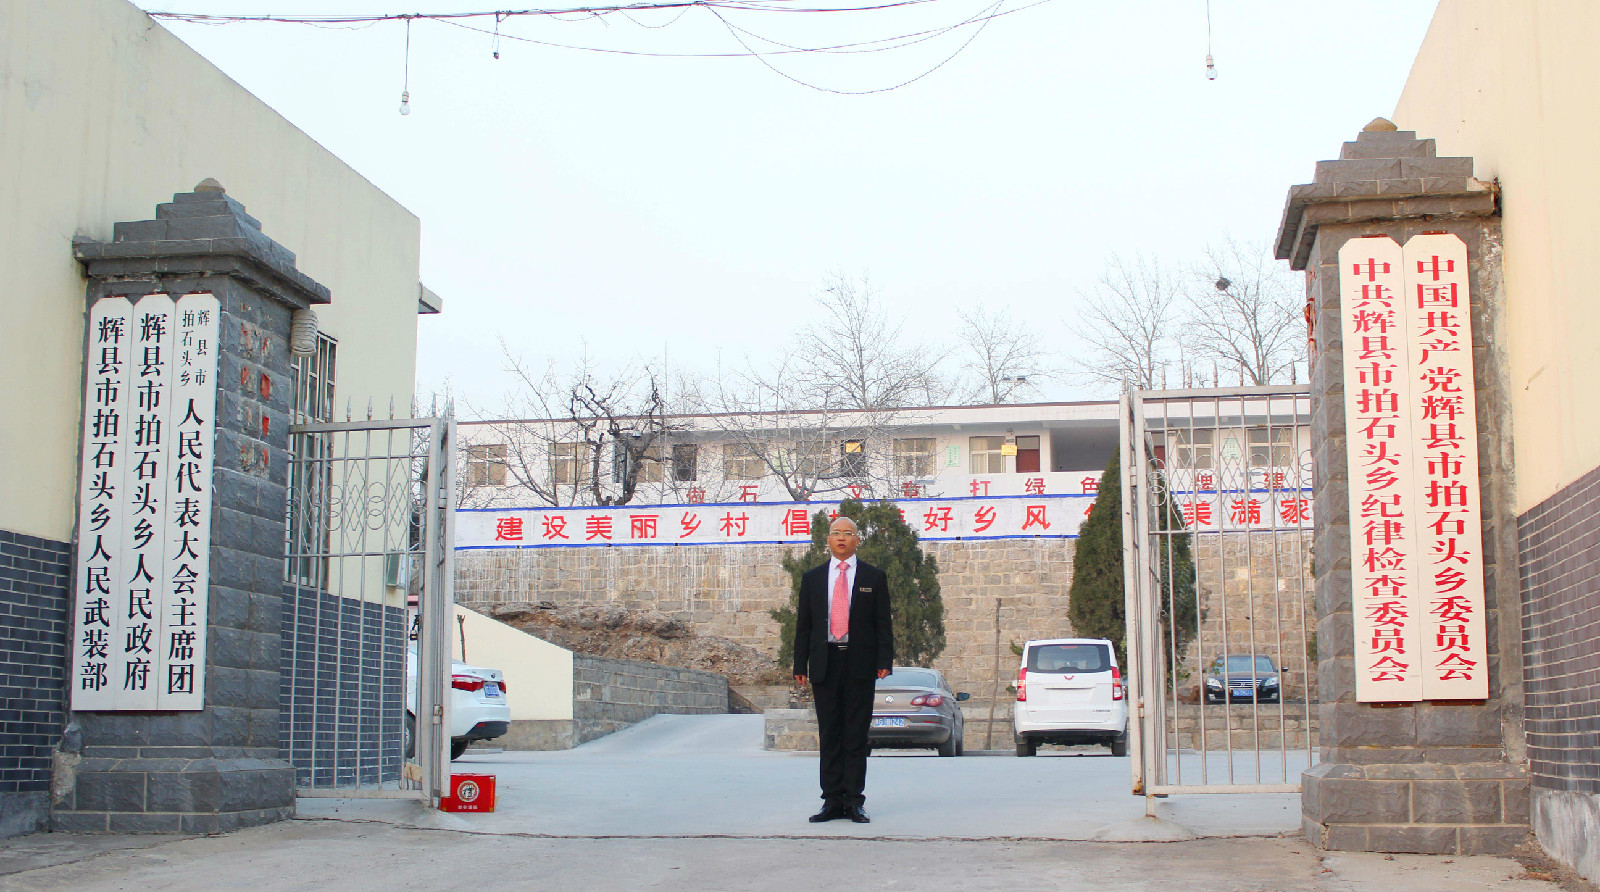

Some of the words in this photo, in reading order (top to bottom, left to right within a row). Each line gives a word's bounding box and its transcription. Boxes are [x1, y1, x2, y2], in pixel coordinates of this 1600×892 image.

[80, 316, 126, 692] 辉县市拍石头乡人民武装部
[123, 312, 168, 692] 辉县市拍石头乡人民政府
[180, 309, 195, 388] 拍石头乡
[196, 309, 211, 387] 辉县市
[1352, 257, 1411, 683] 中共辉县市拍石头乡纪律检查委员会
[1416, 254, 1478, 682] 中国共产党辉县市拍石头乡委员会
[167, 398, 205, 696] 人民代表大会主席团
[495, 511, 750, 542] 建设美丽乡村
